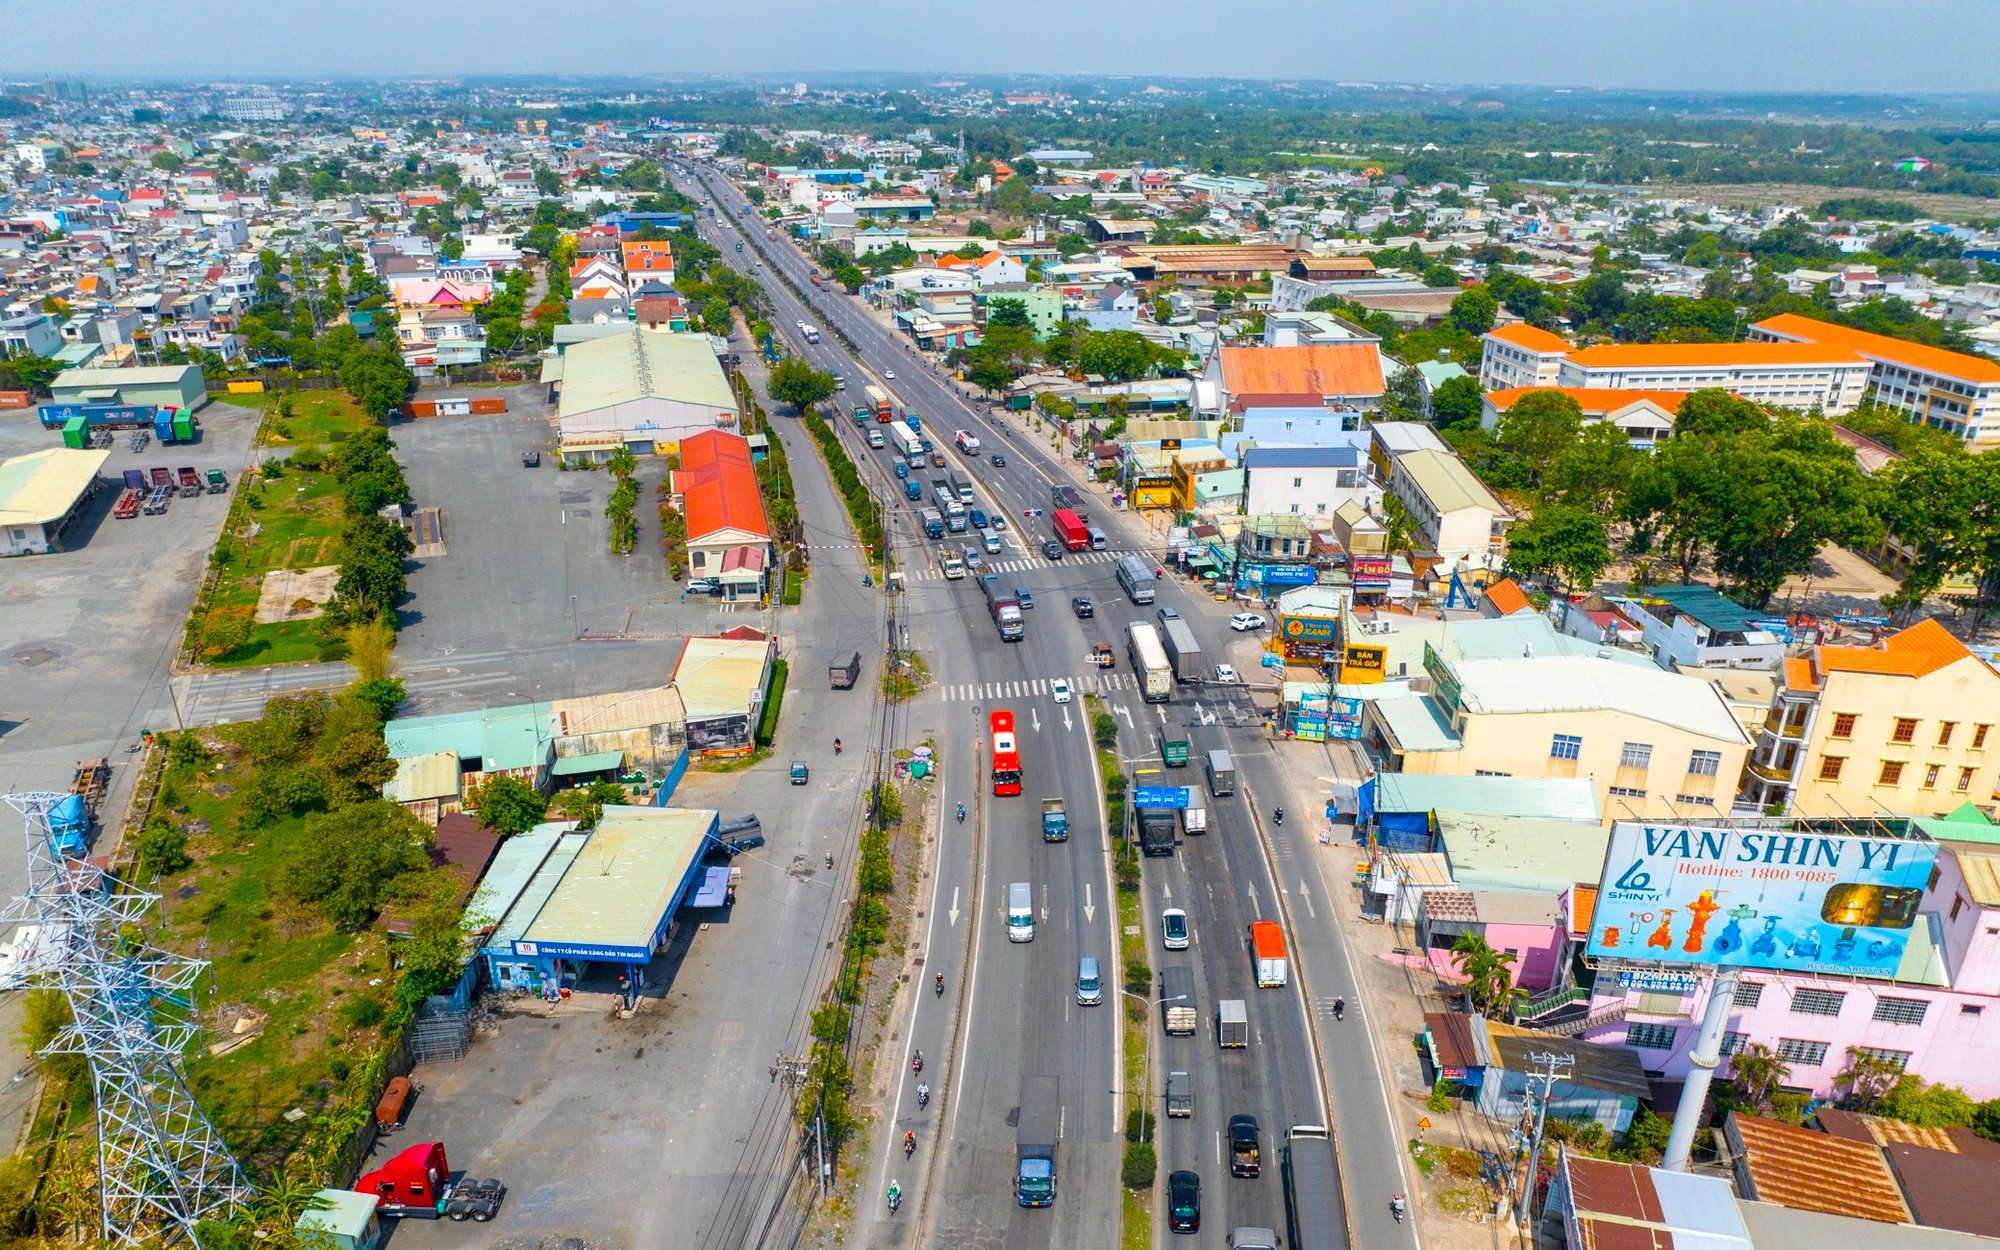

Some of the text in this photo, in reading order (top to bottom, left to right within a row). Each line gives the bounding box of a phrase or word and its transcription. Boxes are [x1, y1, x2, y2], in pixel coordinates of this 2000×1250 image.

[1357, 651, 1373, 659] BÁN
[1364, 659, 1380, 667] GÓP
[1644, 828, 1902, 871] VAN SHIN YI
[1679, 862, 1838, 883] Hotline: 1800 9085
[1607, 892, 1645, 900] SHIN
[541, 946, 557, 954] CÔNG
[1632, 972, 1697, 983] BIZMAN.VN
